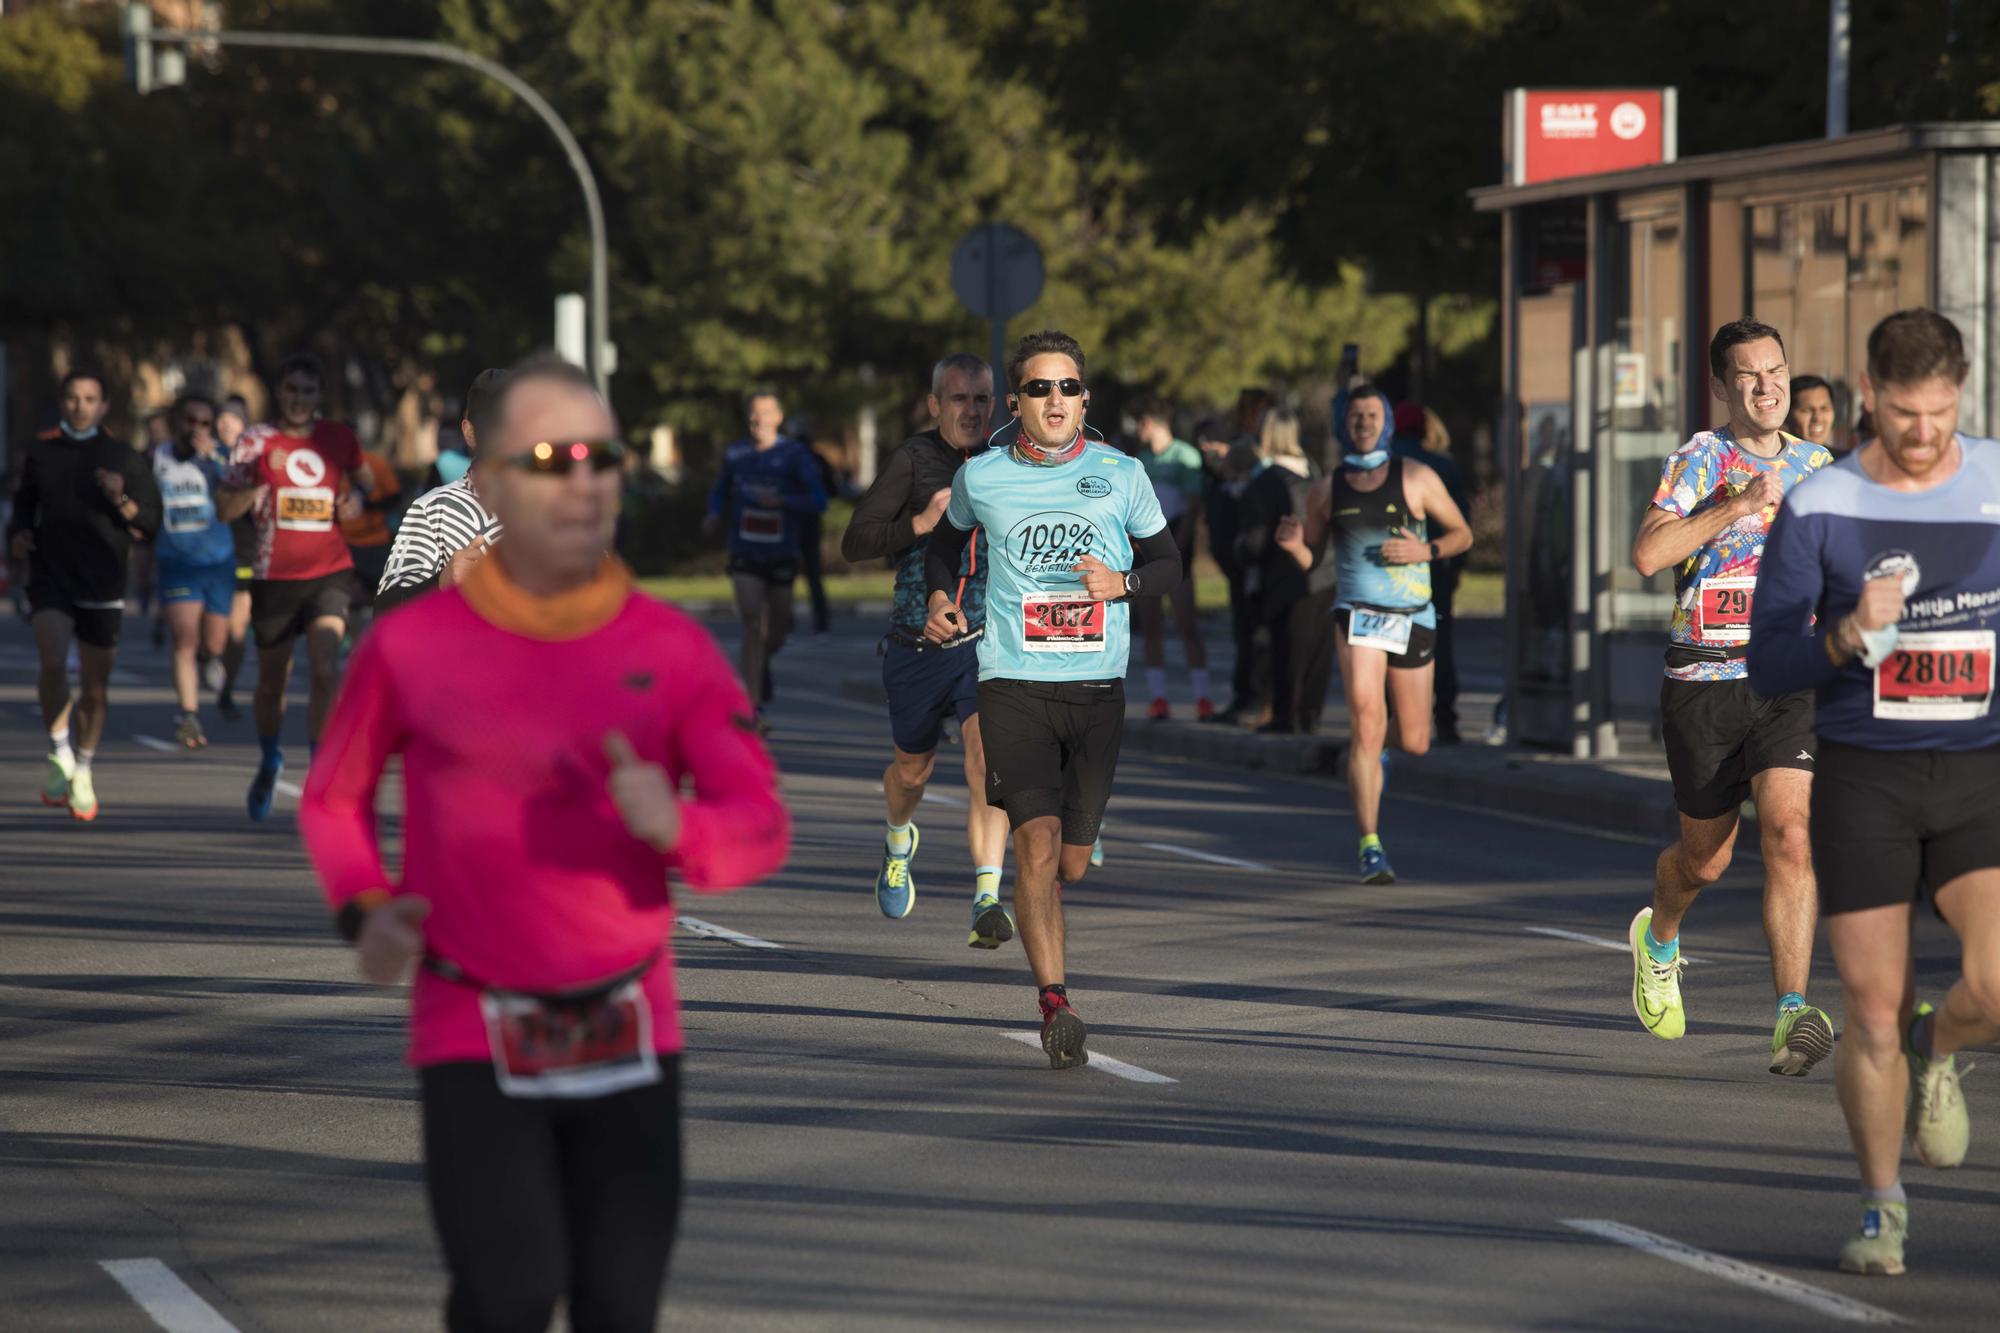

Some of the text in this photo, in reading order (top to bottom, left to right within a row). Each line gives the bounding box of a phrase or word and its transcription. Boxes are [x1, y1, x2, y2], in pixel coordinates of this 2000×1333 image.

[1018, 523, 1093, 561] 100%
[1024, 563, 1075, 573] BENETUS
[1717, 589, 1749, 614] 29
[1895, 651, 1975, 684] 2804
